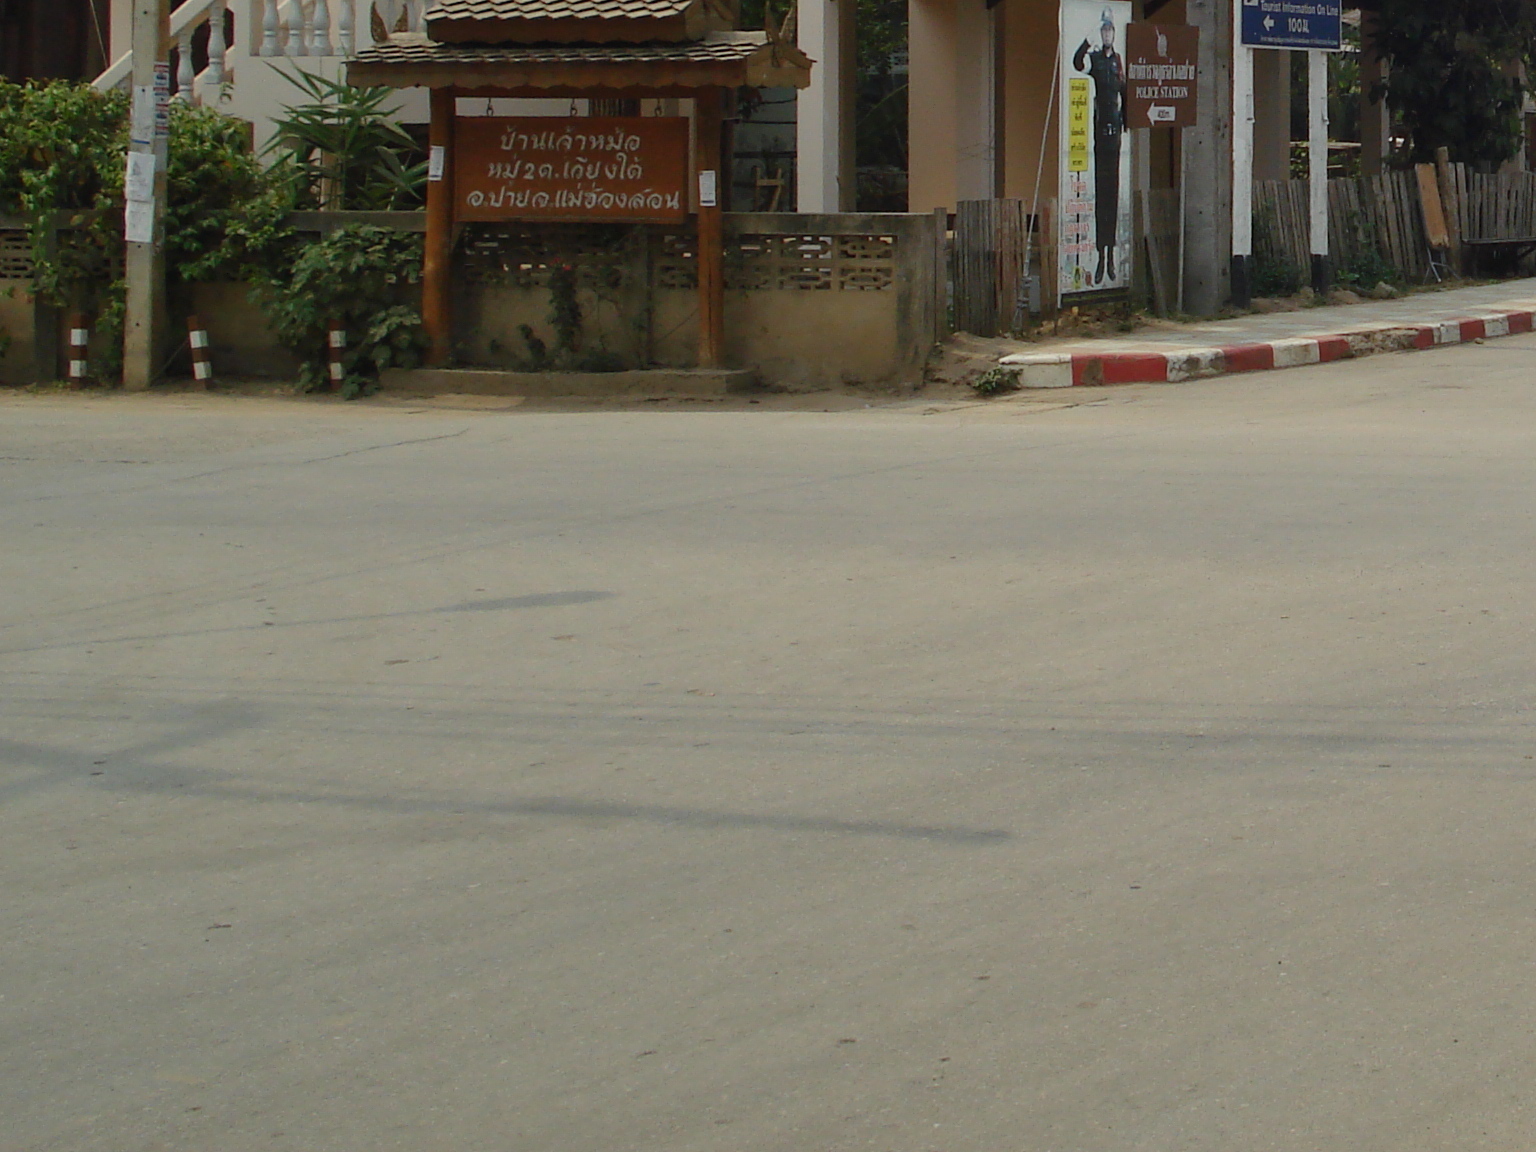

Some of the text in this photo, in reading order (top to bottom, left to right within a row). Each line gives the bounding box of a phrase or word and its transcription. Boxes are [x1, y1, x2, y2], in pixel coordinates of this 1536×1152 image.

[1260, 0, 1339, 16] Tourist Information On Line
[1135, 86, 1189, 99] POLICE STATION
